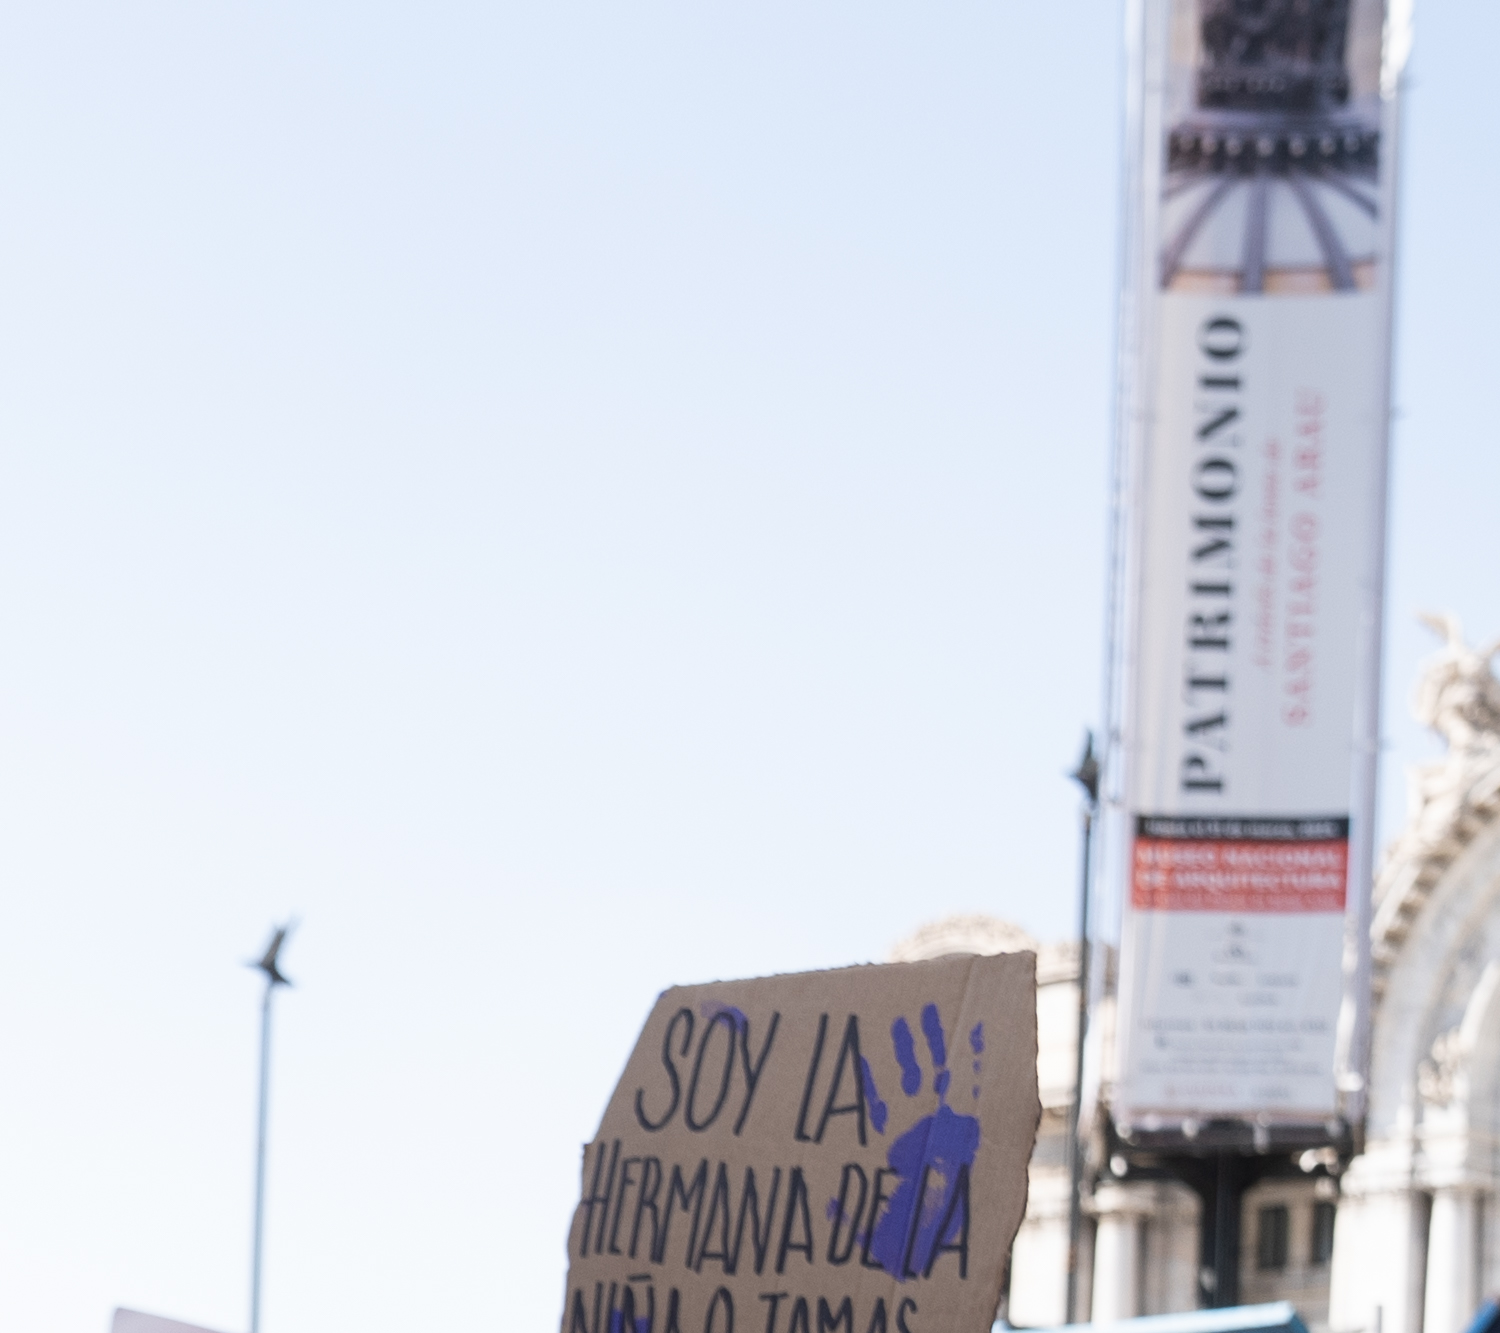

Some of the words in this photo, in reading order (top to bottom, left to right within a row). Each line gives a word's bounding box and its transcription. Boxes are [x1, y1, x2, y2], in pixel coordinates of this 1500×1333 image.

[1181, 314, 1245, 795] PATRIMONIO
[634, 1007, 781, 1137] SOY
[795, 1013, 869, 1147] LA
[579, 1138, 814, 1277] HERMANA
[827, 1162, 898, 1271] DE
[903, 1162, 972, 1281] LA
